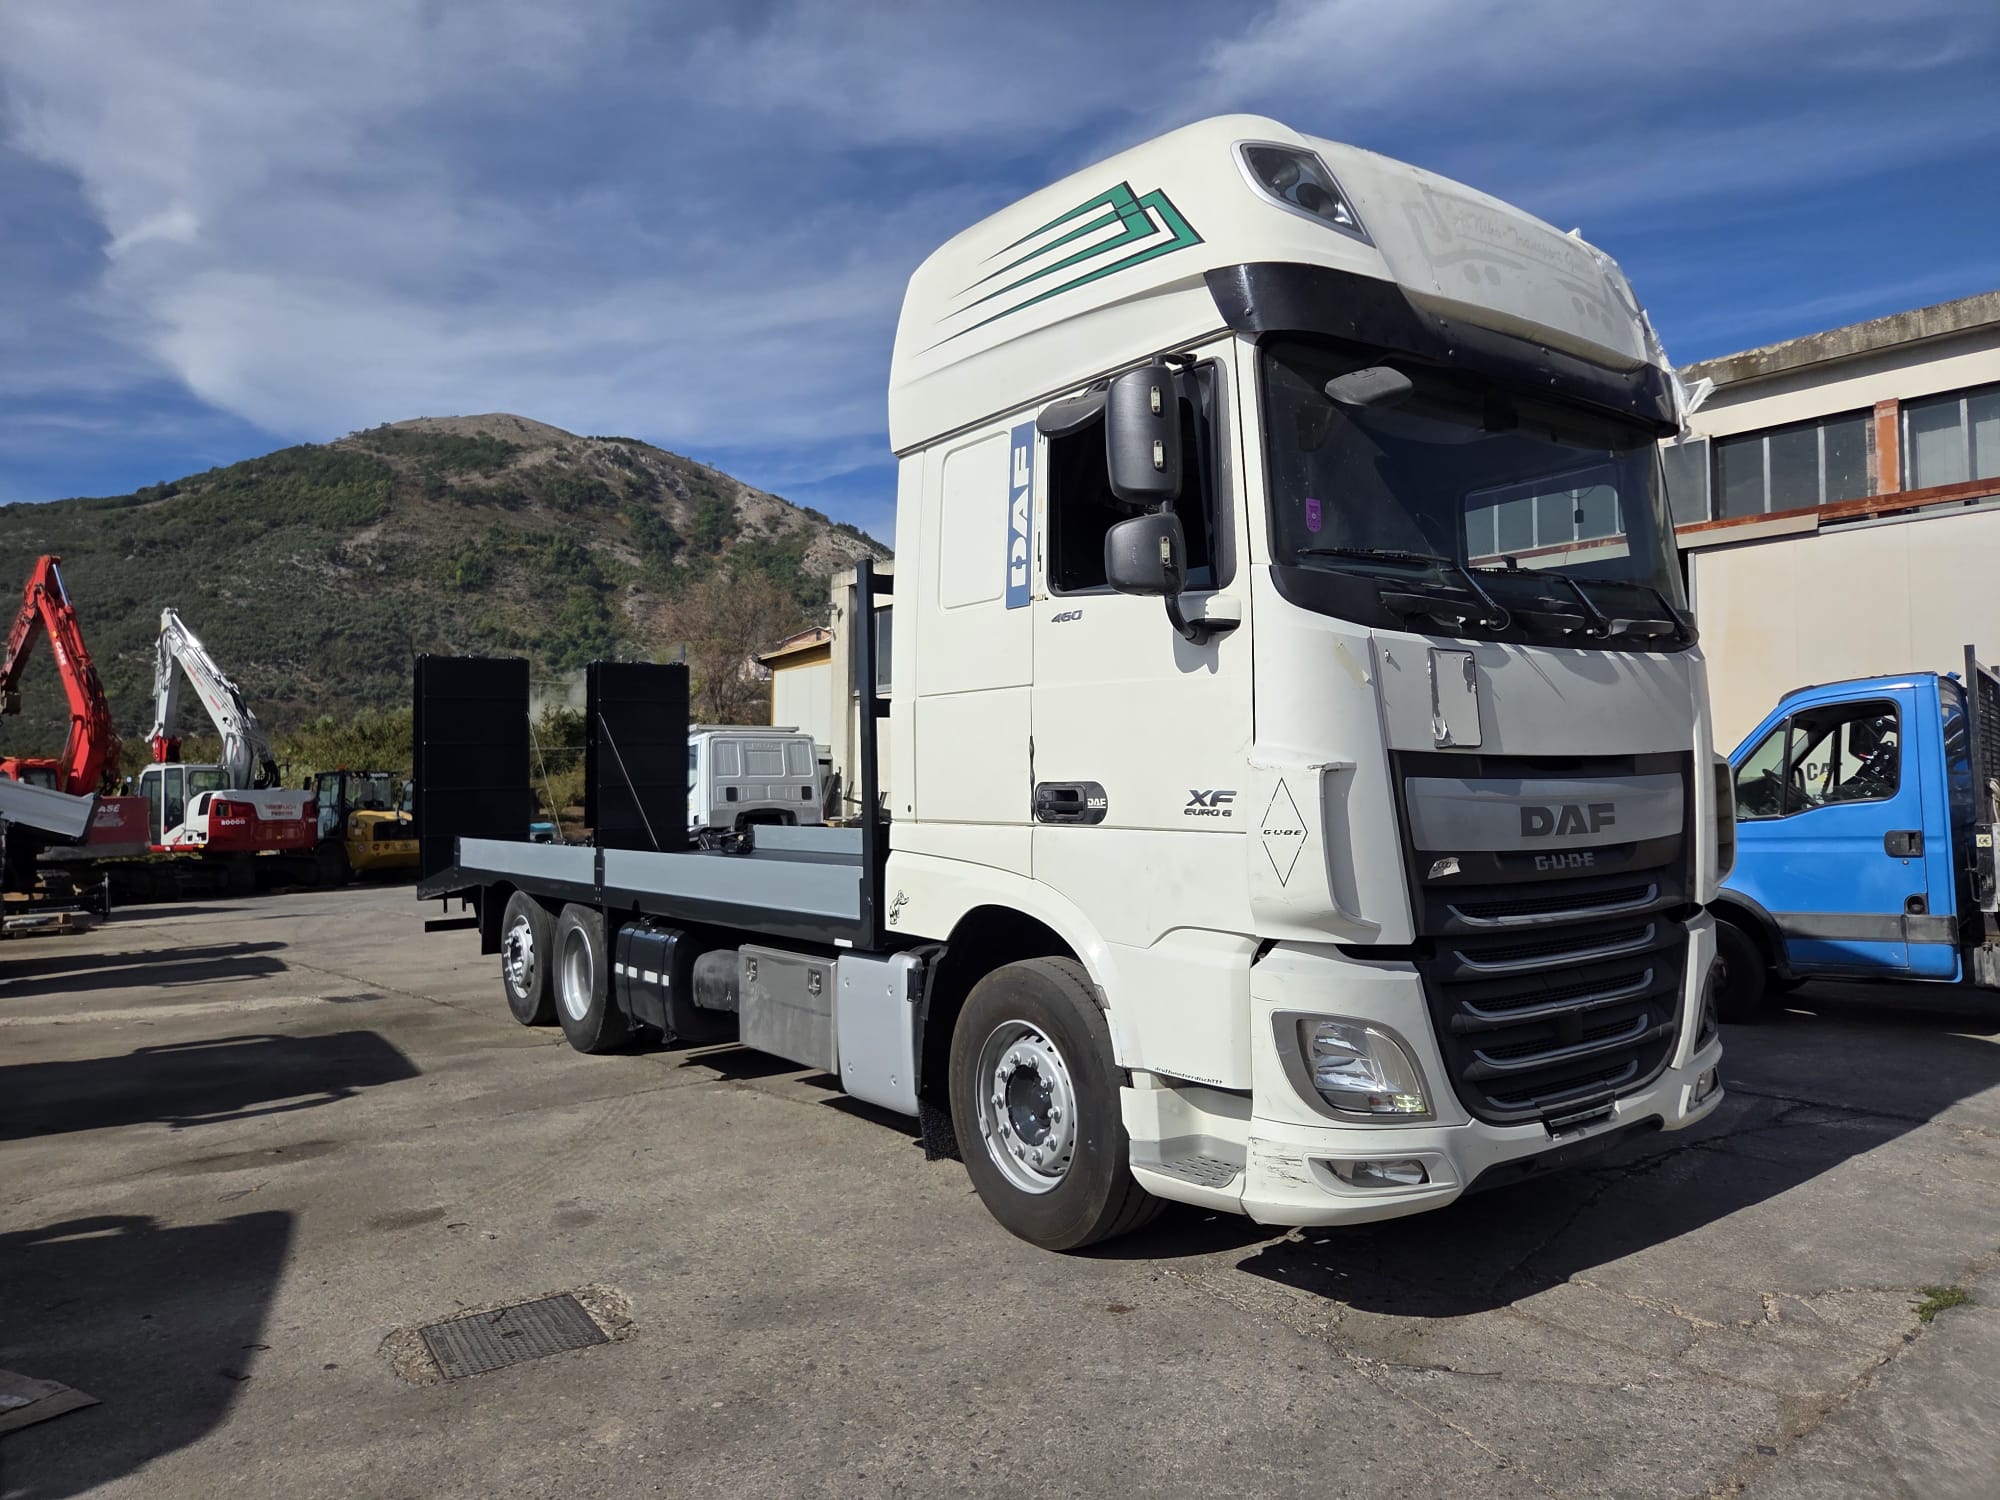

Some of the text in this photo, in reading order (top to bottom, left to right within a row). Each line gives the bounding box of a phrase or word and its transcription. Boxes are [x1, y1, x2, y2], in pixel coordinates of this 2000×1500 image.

[1011, 446, 1030, 588] DAF
[1051, 609, 1083, 624] 460
[1806, 762, 1842, 781] CA
[1087, 797, 1106, 807] DAF
[1186, 789, 1237, 807] XF
[1184, 808, 1233, 818] EURO 6
[1520, 803, 1616, 837] DAF
[1534, 852, 1595, 871] GUDE
